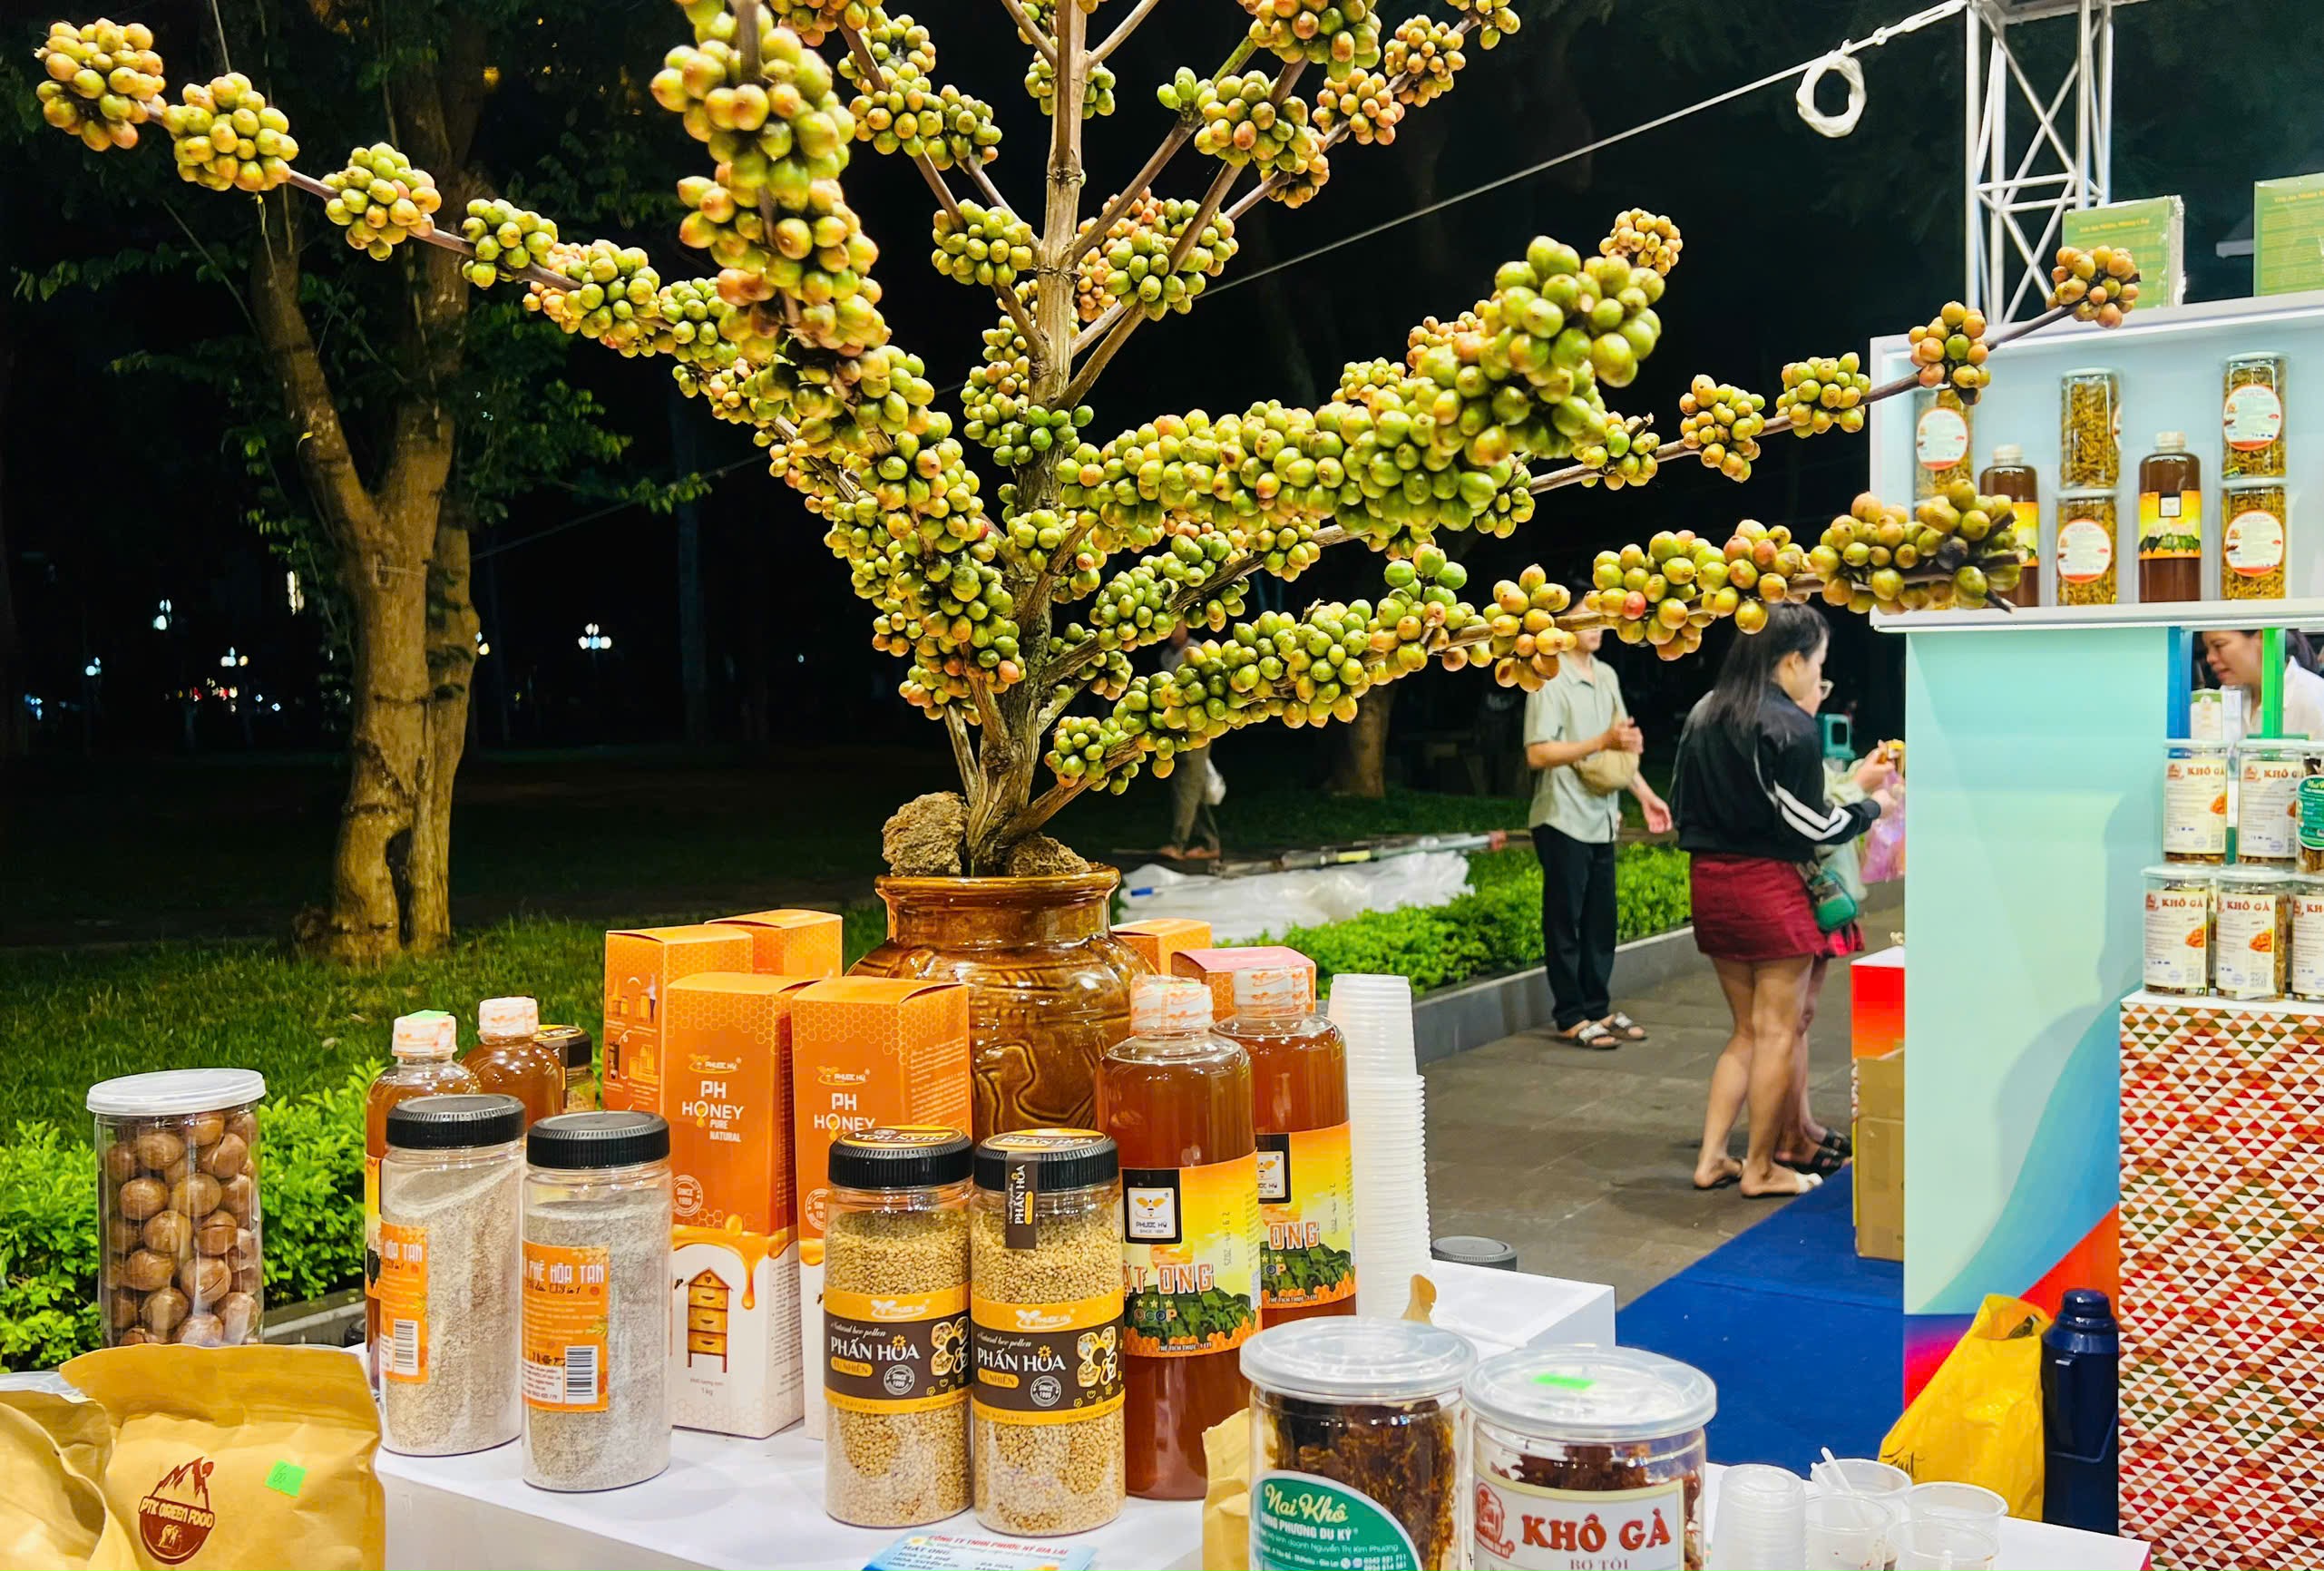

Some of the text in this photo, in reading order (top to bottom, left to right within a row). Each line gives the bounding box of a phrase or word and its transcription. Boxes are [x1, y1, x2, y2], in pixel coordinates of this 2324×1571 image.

[700, 1080, 727, 1098] PH
[681, 1100, 745, 1119] HONEY
[831, 1092, 856, 1110] PH
[709, 1118, 728, 1129] PURE
[814, 1113, 876, 1131] HONEY
[709, 1130, 741, 1143] NATURAL
[1269, 1221, 1320, 1251] ONG
[403, 1244, 423, 1263] TAN
[580, 1264, 604, 1284] TAN
[1157, 1263, 1215, 1295] ONG
[1134, 1308, 1177, 1322] OCOP
[863, 1327, 887, 1339] pollen
[830, 1335, 922, 1361] PHẤN HOA
[1009, 1338, 1032, 1350] pollen
[977, 1347, 1067, 1372] PHẤN HOA
[892, 1372, 907, 1381] SINCE
[1039, 1384, 1053, 1392] SINCE
[141, 1498, 159, 1515] PTK
[188, 1509, 214, 1527] FOOD
[1265, 1483, 1349, 1524] Nai Khô
[1320, 1527, 1334, 1541] DU
[1521, 1508, 1671, 1554] KHÔ GÀ
